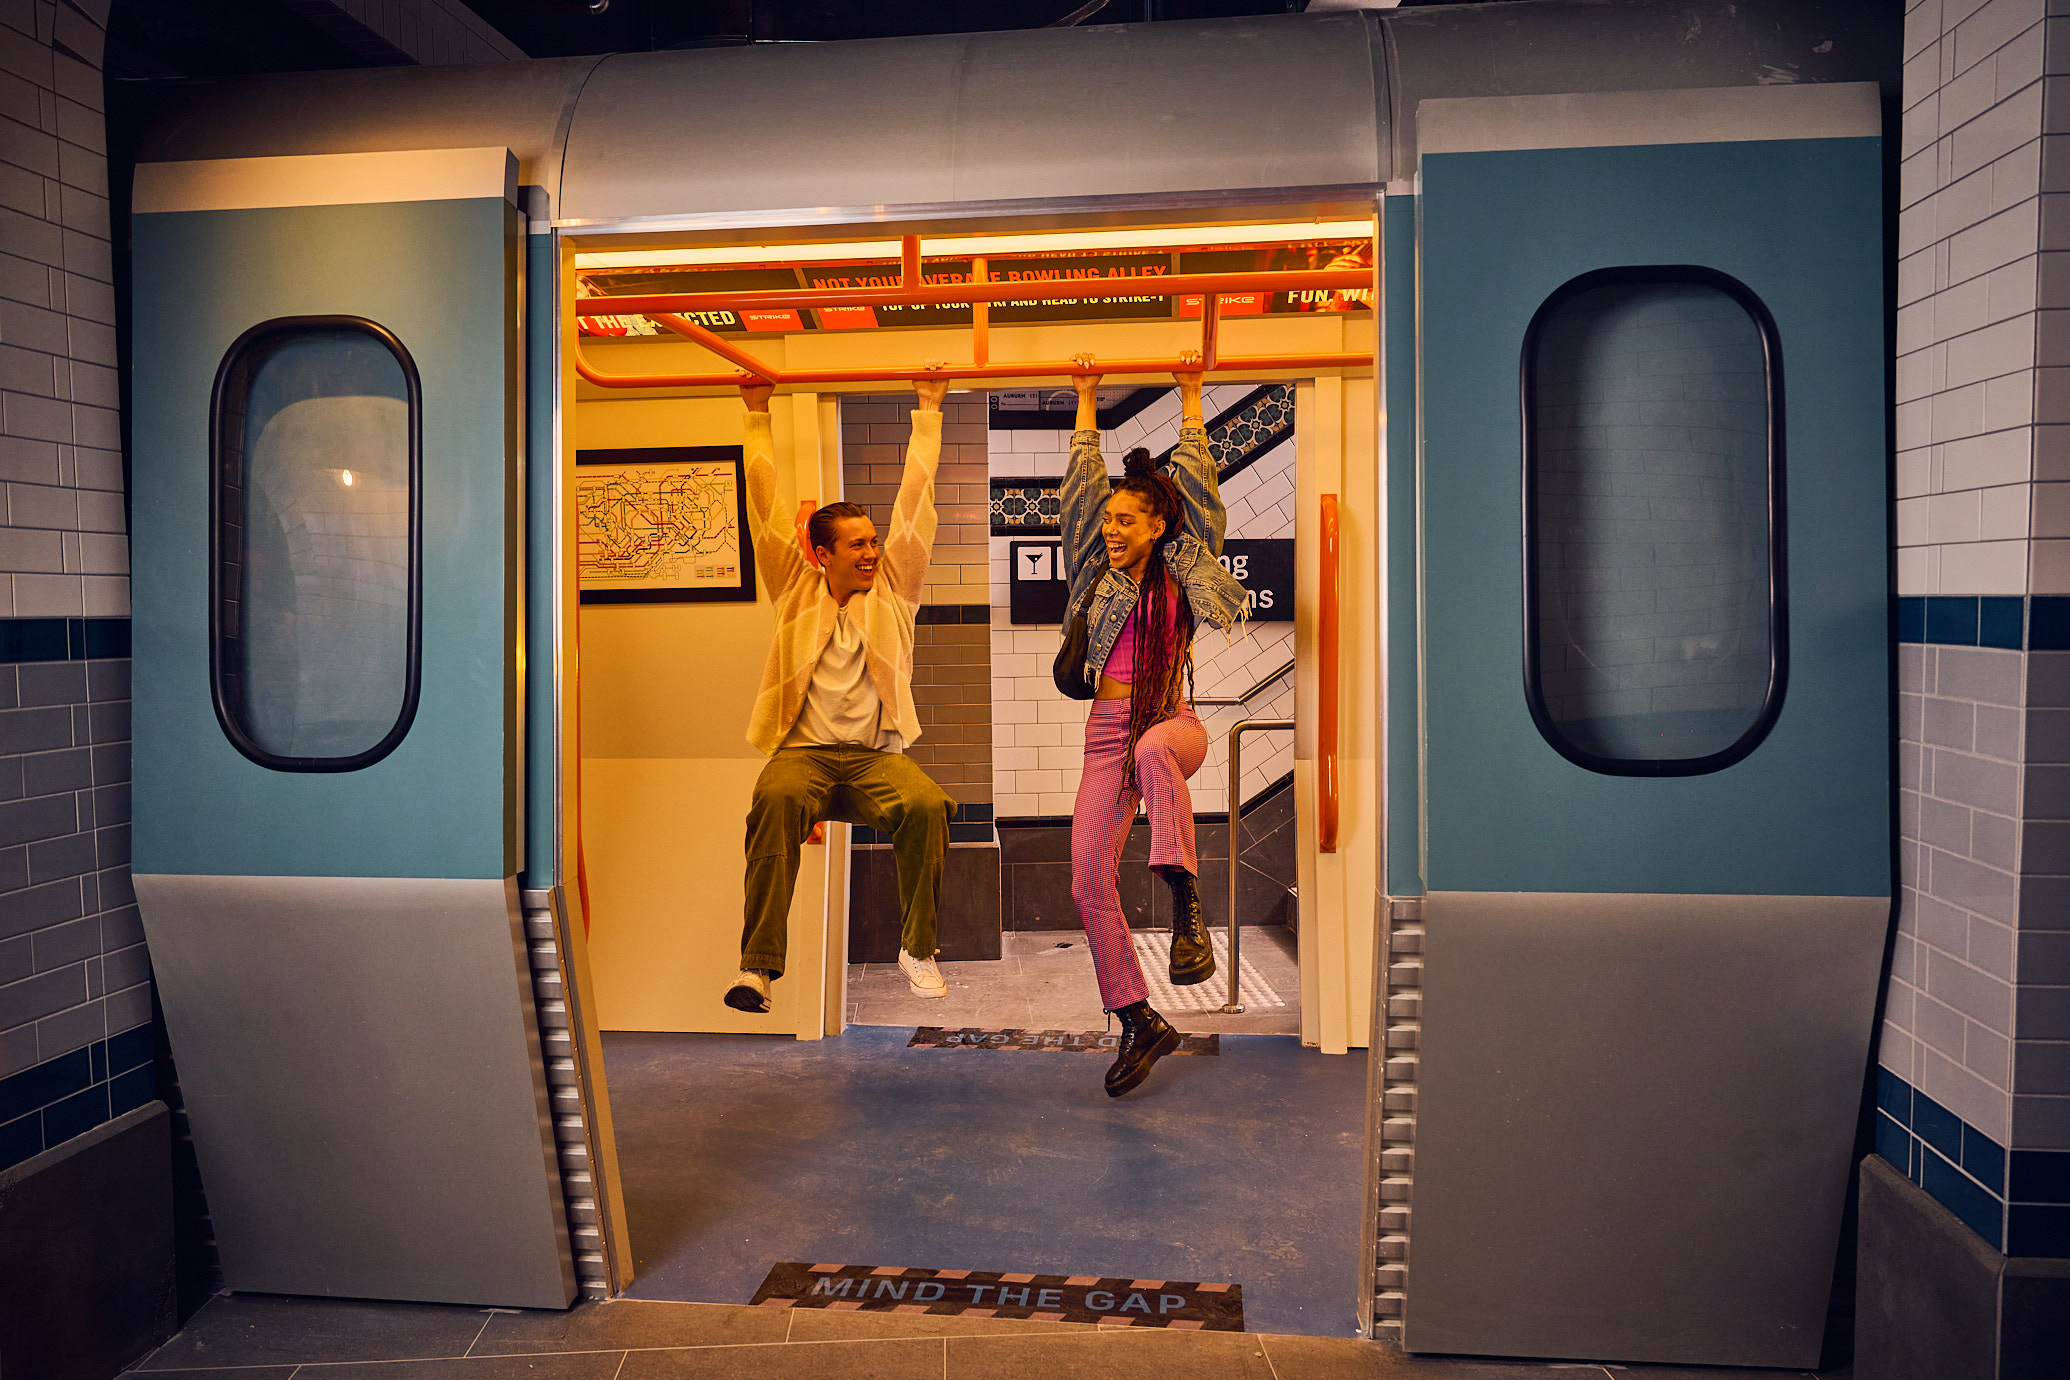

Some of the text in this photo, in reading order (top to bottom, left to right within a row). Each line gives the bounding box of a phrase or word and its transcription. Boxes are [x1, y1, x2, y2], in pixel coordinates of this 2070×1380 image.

[1186, 296, 1255, 306] SIKE
[1342, 288, 1374, 302] WI
[632, 311, 736, 329] EXCTED
[945, 1033, 1010, 1044] GAP
[1021, 1035, 1085, 1046] THE
[812, 1276, 1187, 1315] MIND THE GAP
